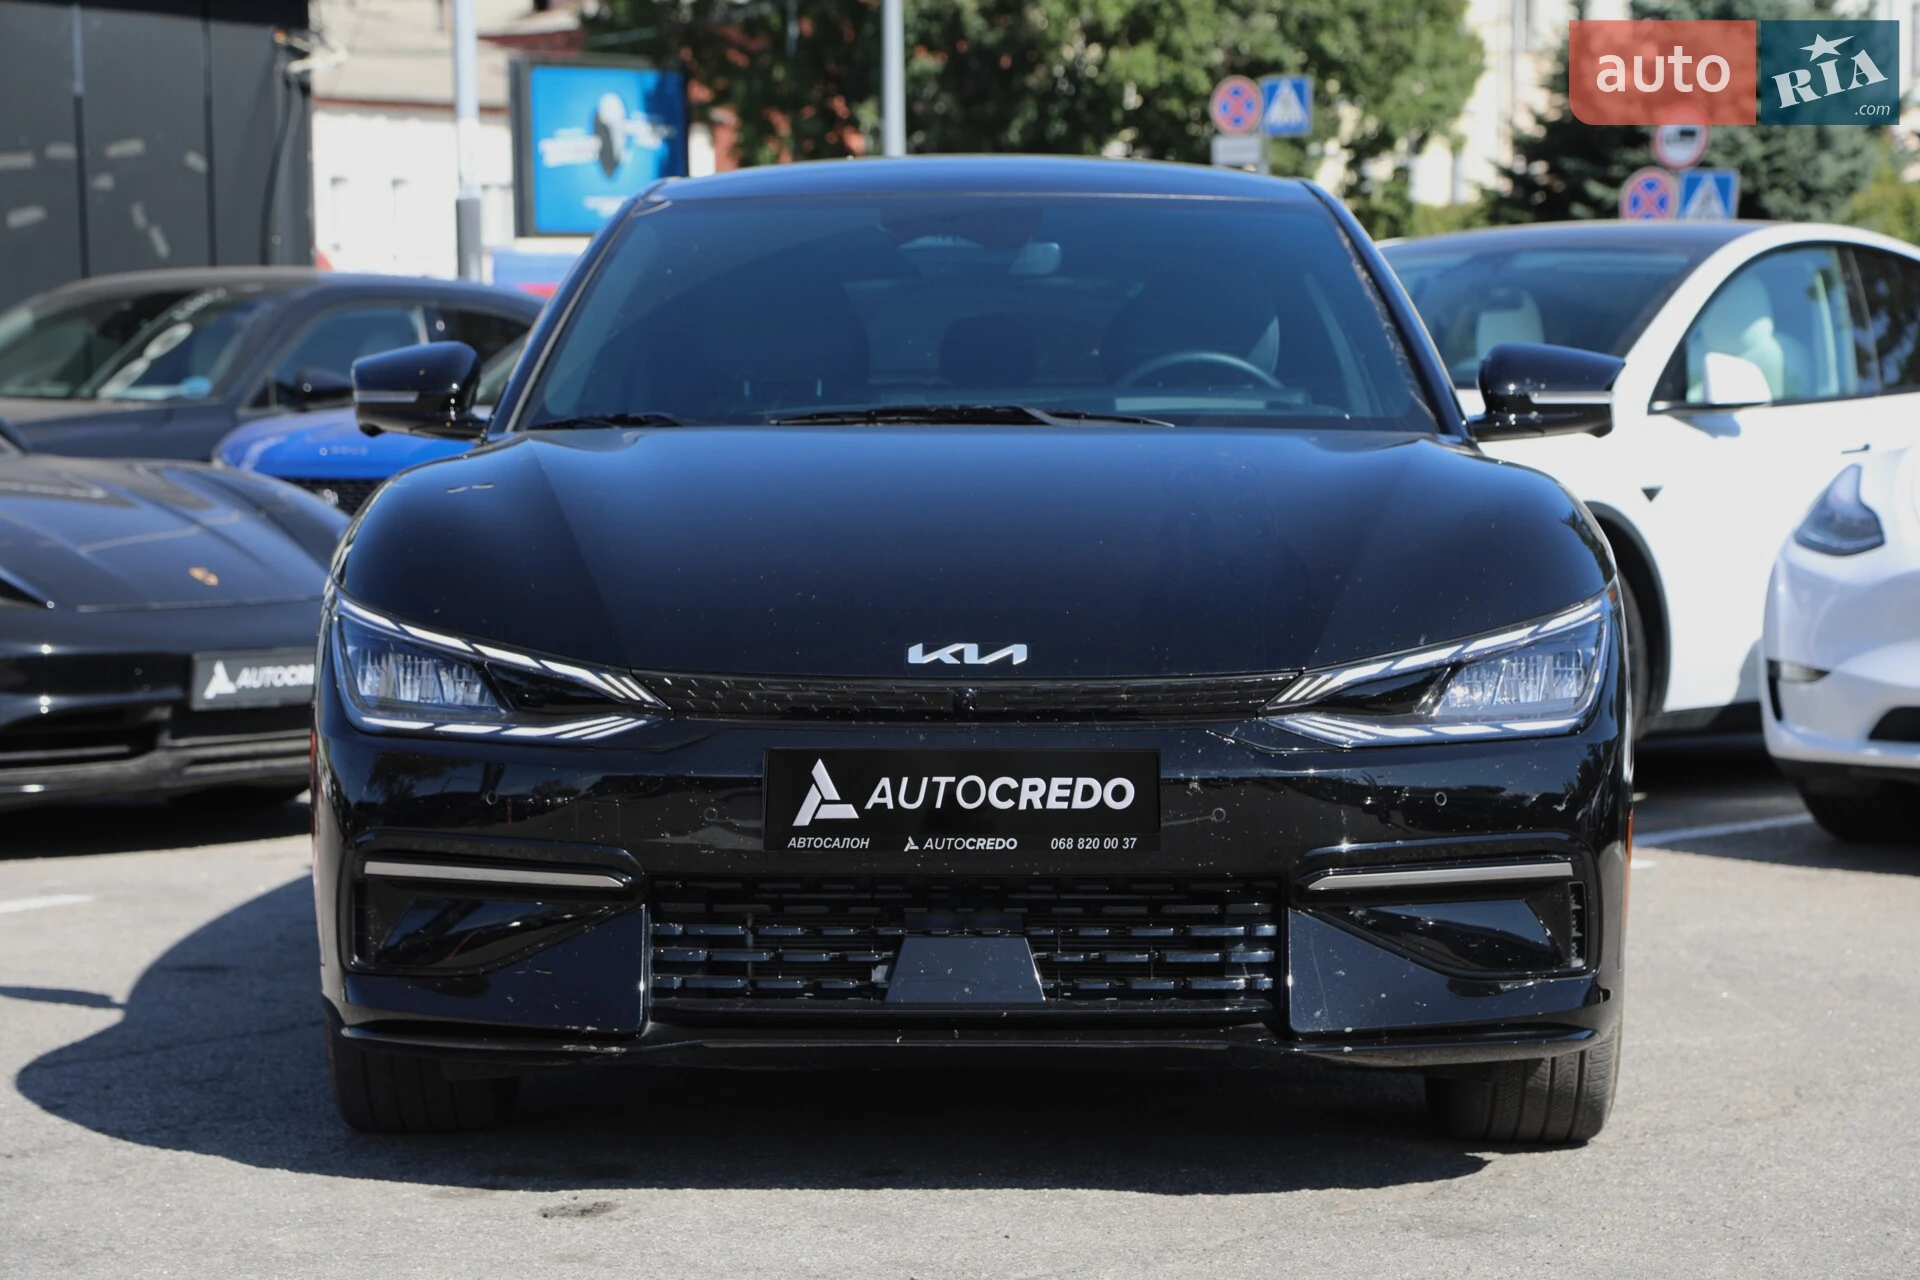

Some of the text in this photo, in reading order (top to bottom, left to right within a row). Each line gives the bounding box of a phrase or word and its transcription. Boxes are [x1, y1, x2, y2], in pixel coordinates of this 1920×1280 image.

[908, 643, 1028, 665] KIA
[864, 774, 1135, 810] AUTOCREDO
[787, 837, 870, 849] АВТОСАЛОН
[923, 837, 1018, 850] AUTOCREDO
[1051, 837, 1138, 850] 068 820 00 37
